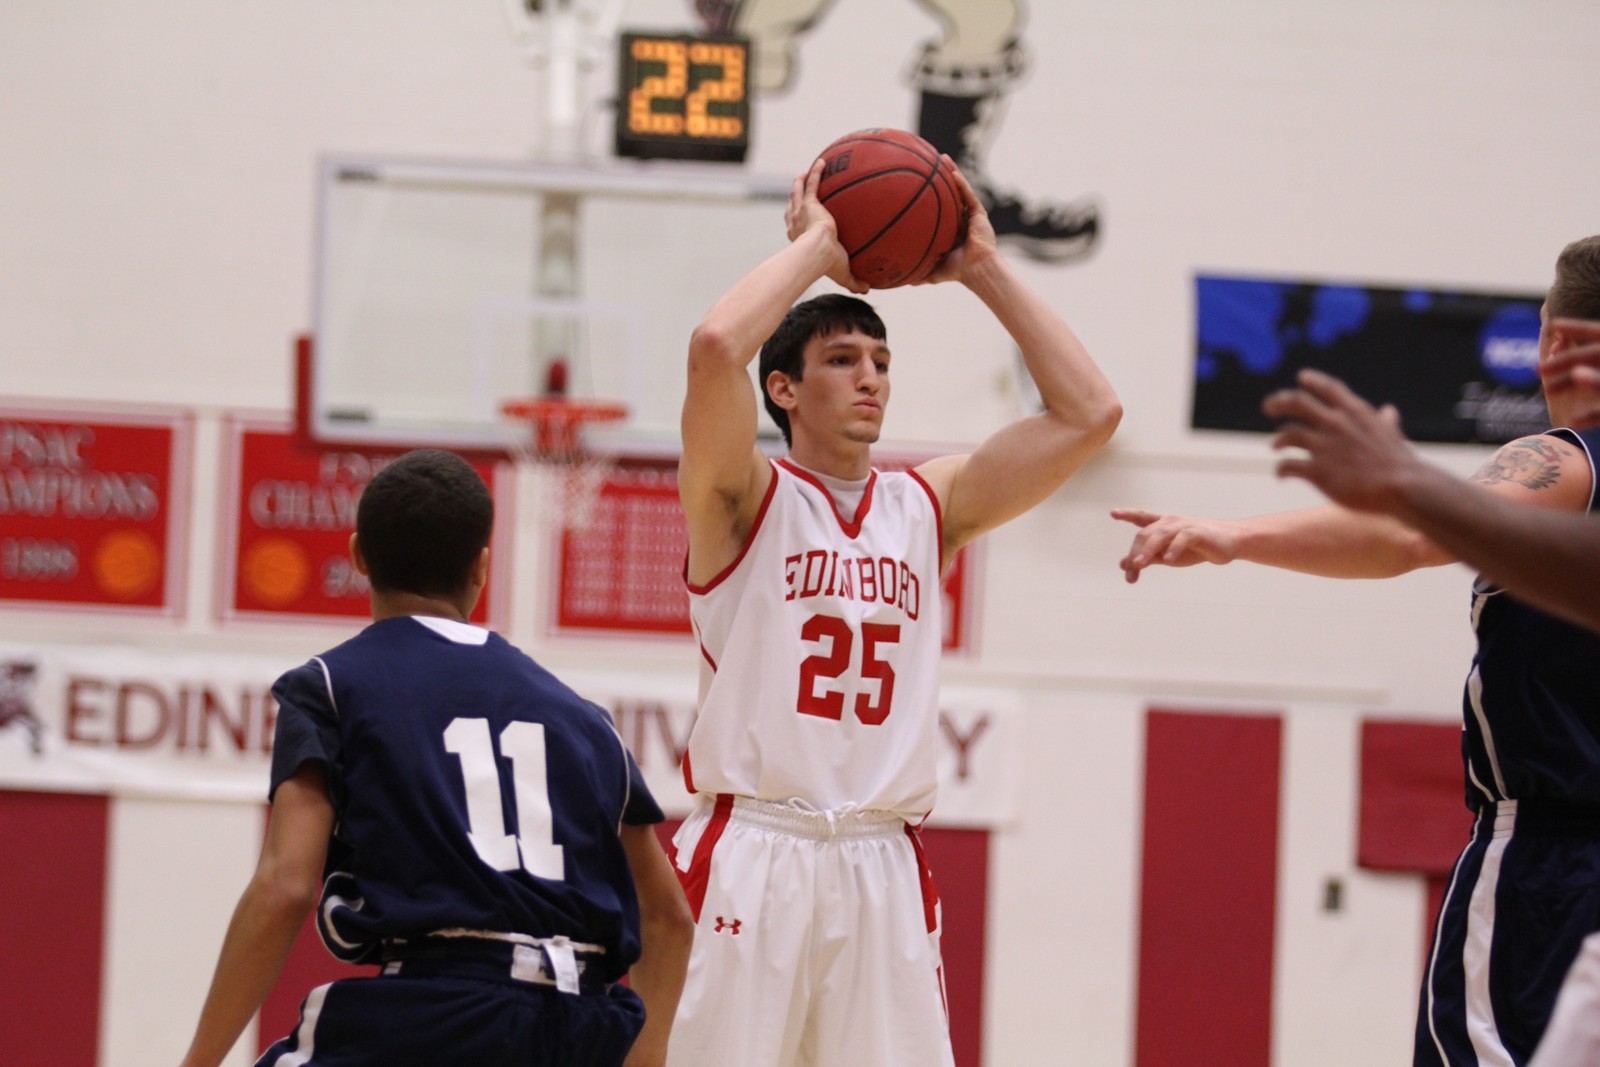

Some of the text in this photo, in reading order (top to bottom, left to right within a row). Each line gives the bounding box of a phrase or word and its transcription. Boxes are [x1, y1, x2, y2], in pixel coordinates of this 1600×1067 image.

[629, 38, 745, 138] 22
[796, 614, 901, 726] 25
[443, 717, 565, 880] 11
